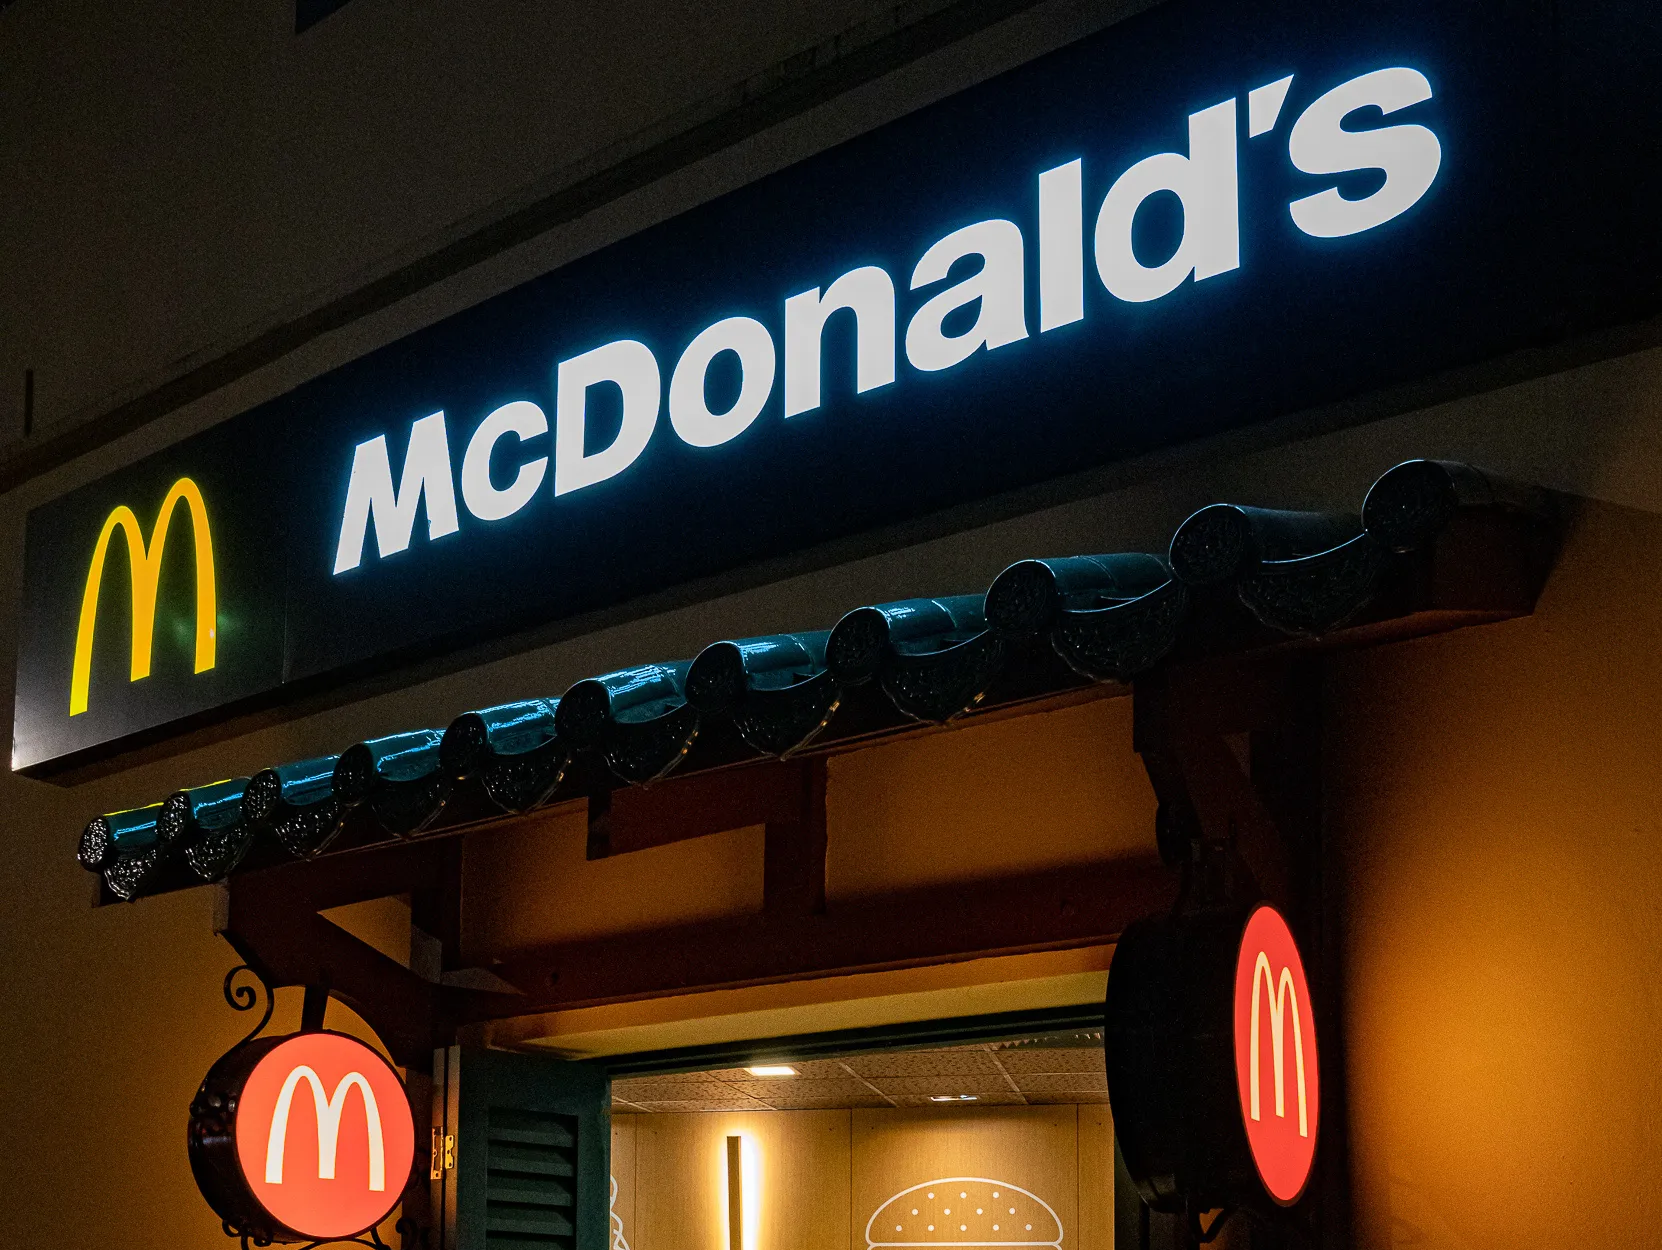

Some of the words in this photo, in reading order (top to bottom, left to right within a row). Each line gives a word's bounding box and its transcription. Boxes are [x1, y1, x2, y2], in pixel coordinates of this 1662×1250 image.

[332, 66, 1443, 577] McDonald's
[69, 475, 218, 718] M
[264, 1064, 385, 1192] M
[1249, 951, 1308, 1138] M
